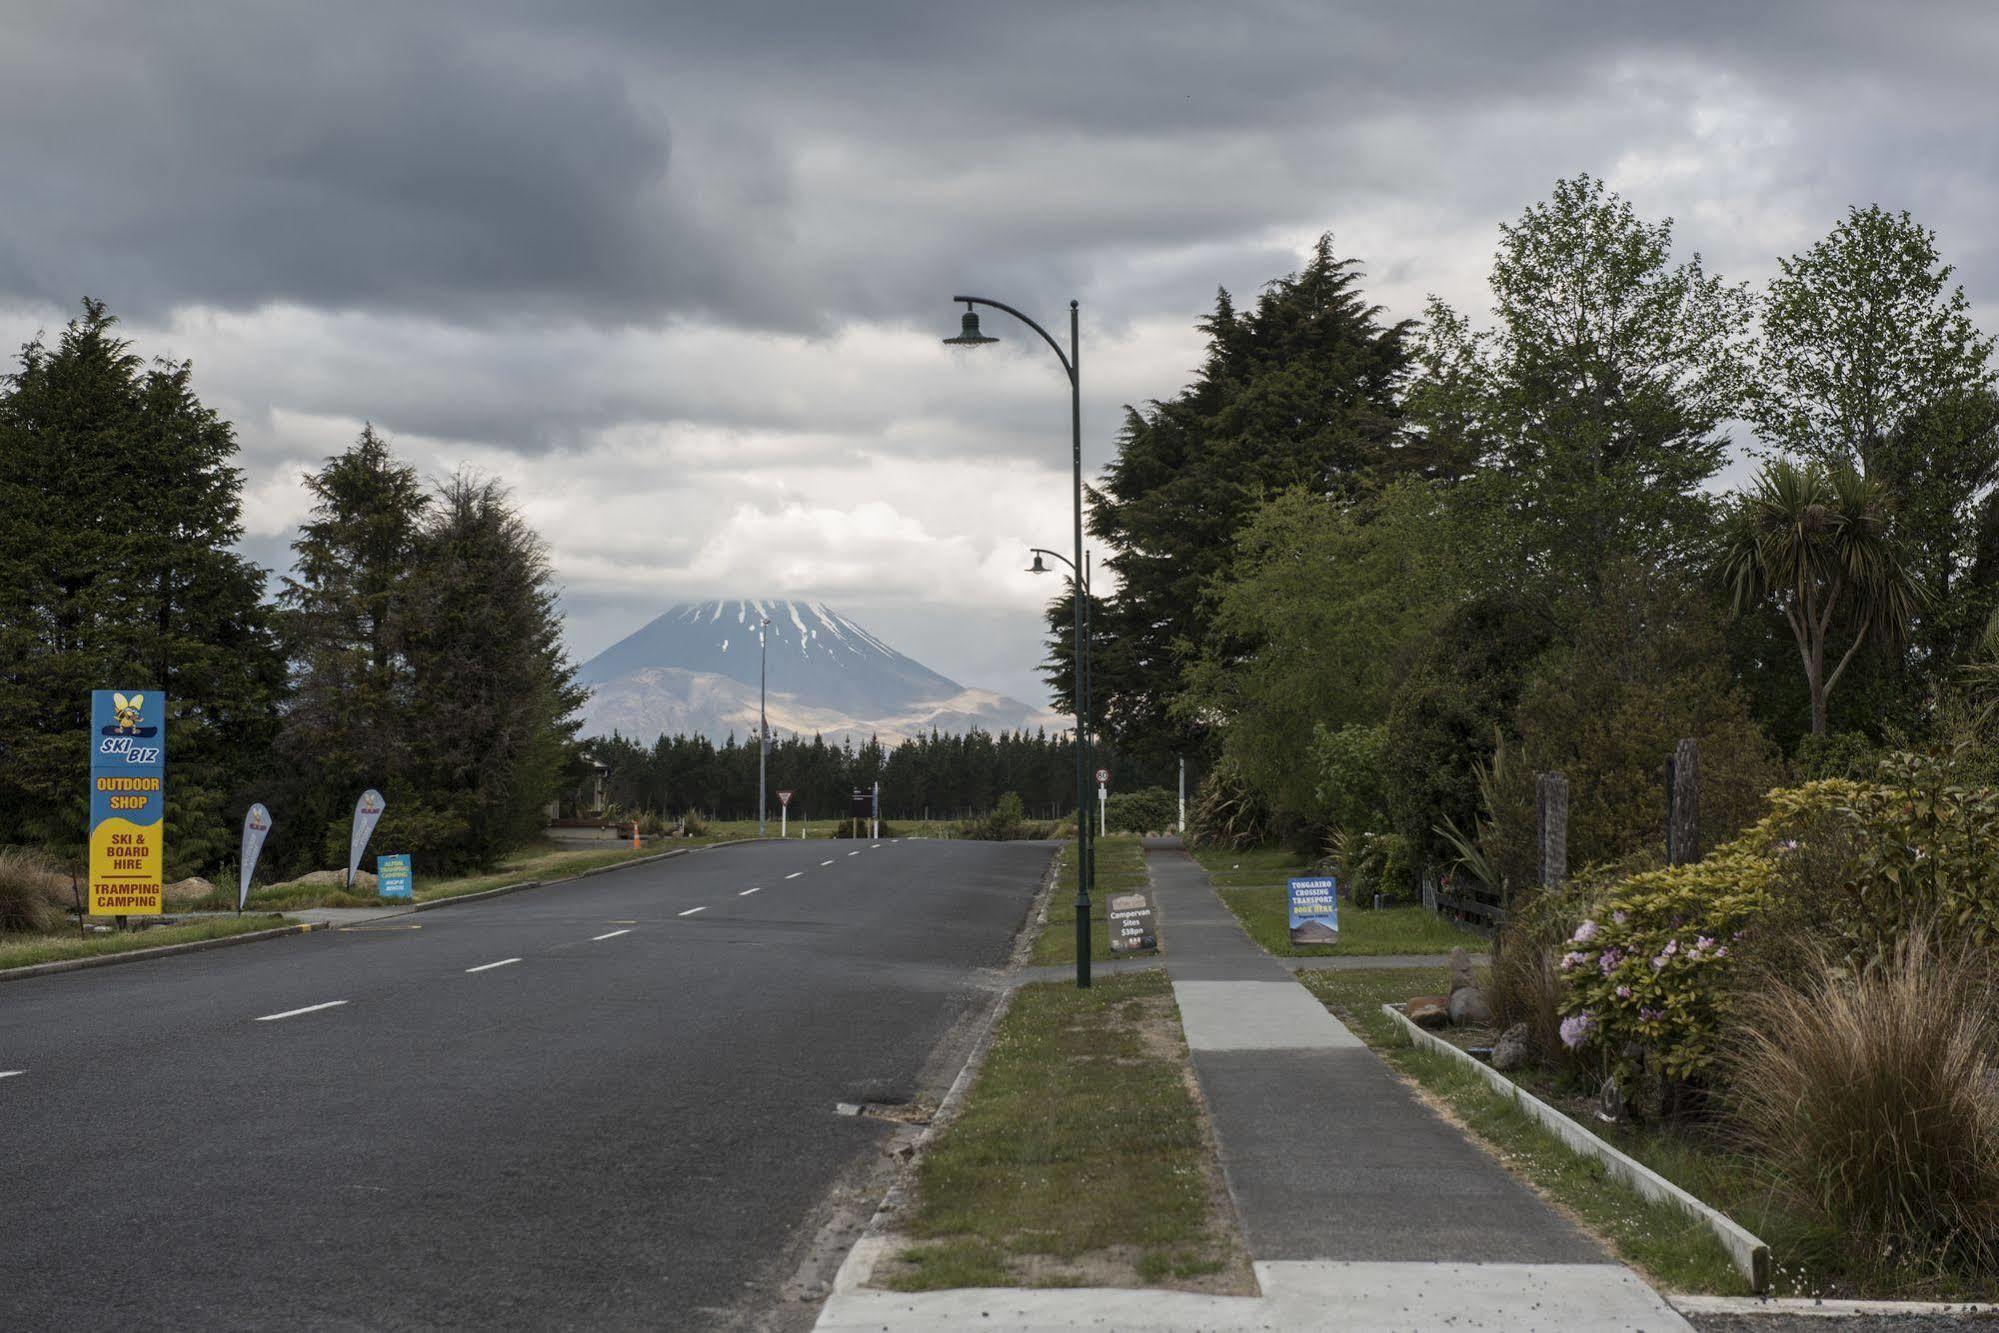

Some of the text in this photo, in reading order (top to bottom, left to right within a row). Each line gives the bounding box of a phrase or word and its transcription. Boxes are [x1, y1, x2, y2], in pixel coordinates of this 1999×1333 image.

[101, 738, 133, 753] SKI
[127, 748, 159, 763] BIZ
[97, 778, 160, 791] OUTDOOR
[110, 796, 148, 809] SHOP
[112, 834, 145, 844] SKI &
[107, 847, 149, 857] BOARD
[114, 860, 142, 869] HIRE
[94, 884, 160, 894] TRAMPING
[1292, 881, 1332, 889] TONGARIRO
[1295, 889, 1329, 897] CROSSING
[98, 896, 156, 907] CAMPING
[1292, 896, 1333, 905] TRANSPORT
[1110, 909, 1151, 919] Campervan
[1122, 919, 1140, 927] Sites
